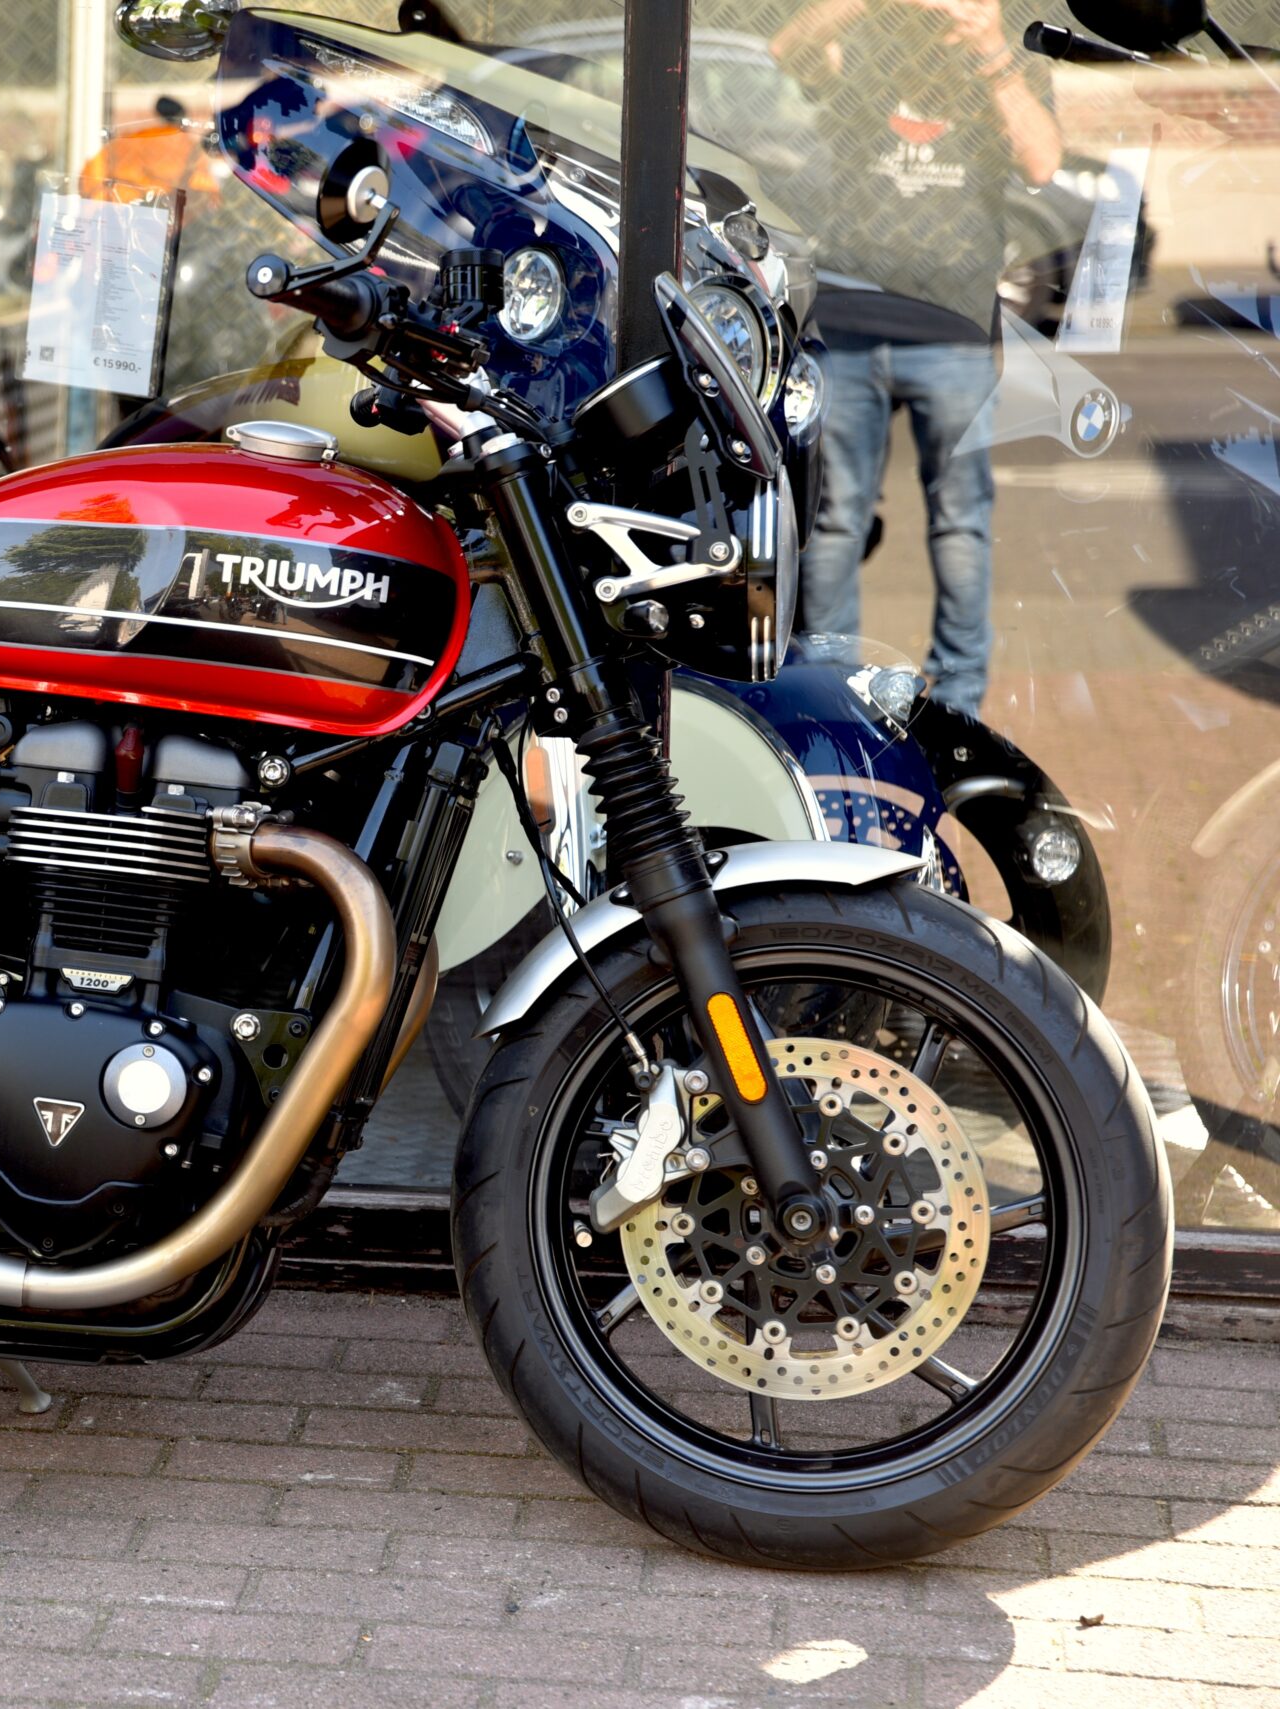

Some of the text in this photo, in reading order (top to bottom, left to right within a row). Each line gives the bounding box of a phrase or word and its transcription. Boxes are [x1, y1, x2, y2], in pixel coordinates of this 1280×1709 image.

[216, 553, 390, 608] TRIUMPH
[769, 926, 954, 976] 120/70ZR17
[970, 1361, 1070, 1464] DUNLOP
